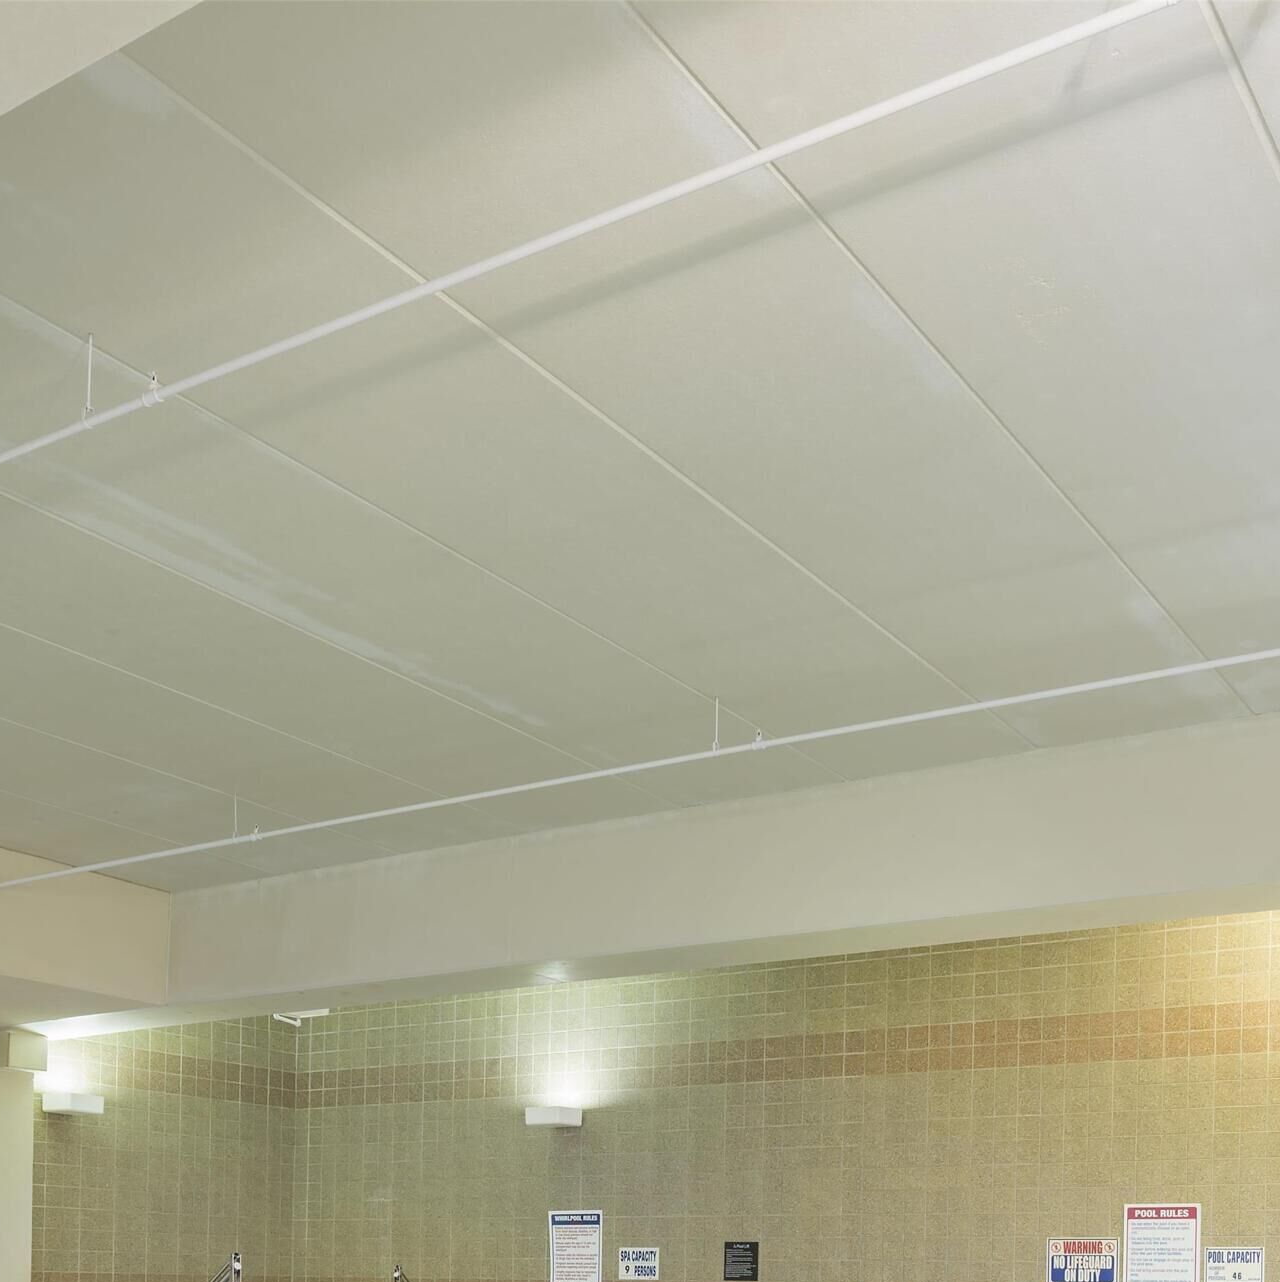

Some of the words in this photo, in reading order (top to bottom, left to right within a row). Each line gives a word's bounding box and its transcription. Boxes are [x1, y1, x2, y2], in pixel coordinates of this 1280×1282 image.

[1135, 1209, 1158, 1218] POOL
[1160, 1209, 1189, 1217] RULES
[1063, 1241, 1103, 1254] WARNING
[621, 1250, 631, 1262] SPA
[632, 1250, 657, 1262] CAPACITY
[1208, 1251, 1224, 1263] POOL
[1227, 1251, 1260, 1263] CAPACITY
[1053, 1256, 1065, 1269] NO
[1067, 1256, 1112, 1269] LIFEGUARD
[625, 1265, 630, 1274] 9
[634, 1265, 657, 1277] PERSONS
[1065, 1269, 1077, 1282] ON
[1078, 1269, 1101, 1282] DUTY
[1232, 1272, 1242, 1280] 46
